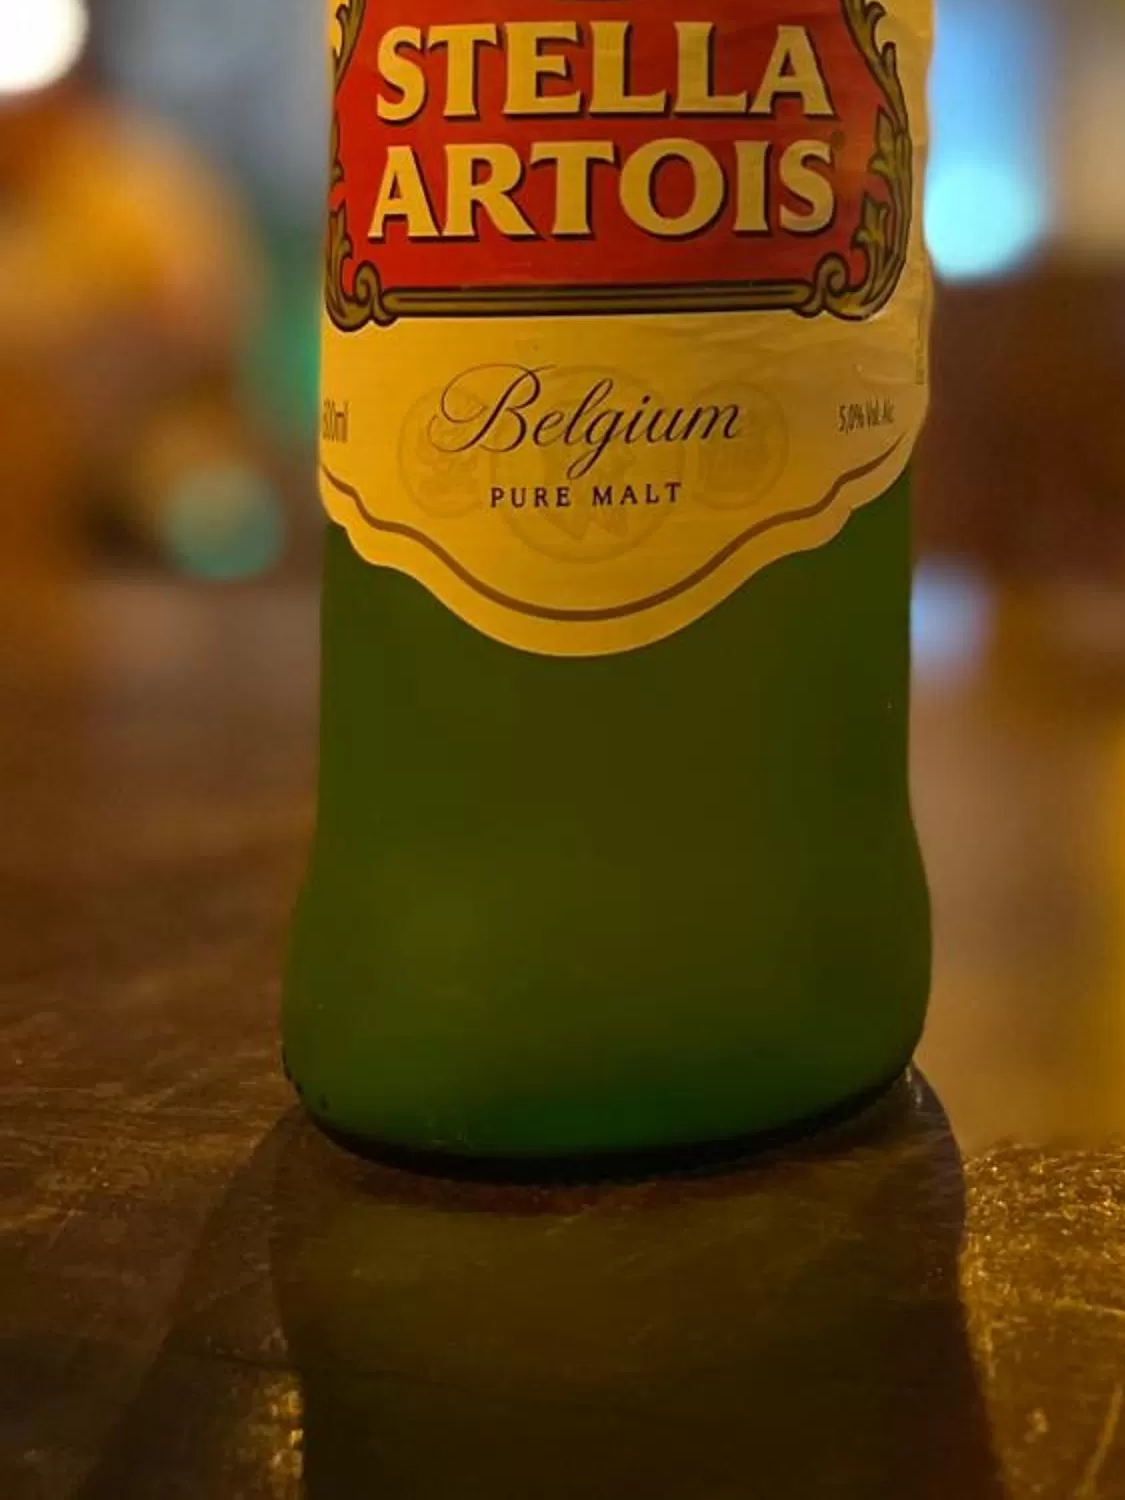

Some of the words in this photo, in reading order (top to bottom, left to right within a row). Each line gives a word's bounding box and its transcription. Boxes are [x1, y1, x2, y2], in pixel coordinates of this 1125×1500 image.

[376, 21, 836, 121] STELLA
[367, 137, 836, 243] ARTOIS
[427, 363, 741, 481] Belgium
[490, 486, 572, 508] PURE
[592, 481, 682, 506] MALT
